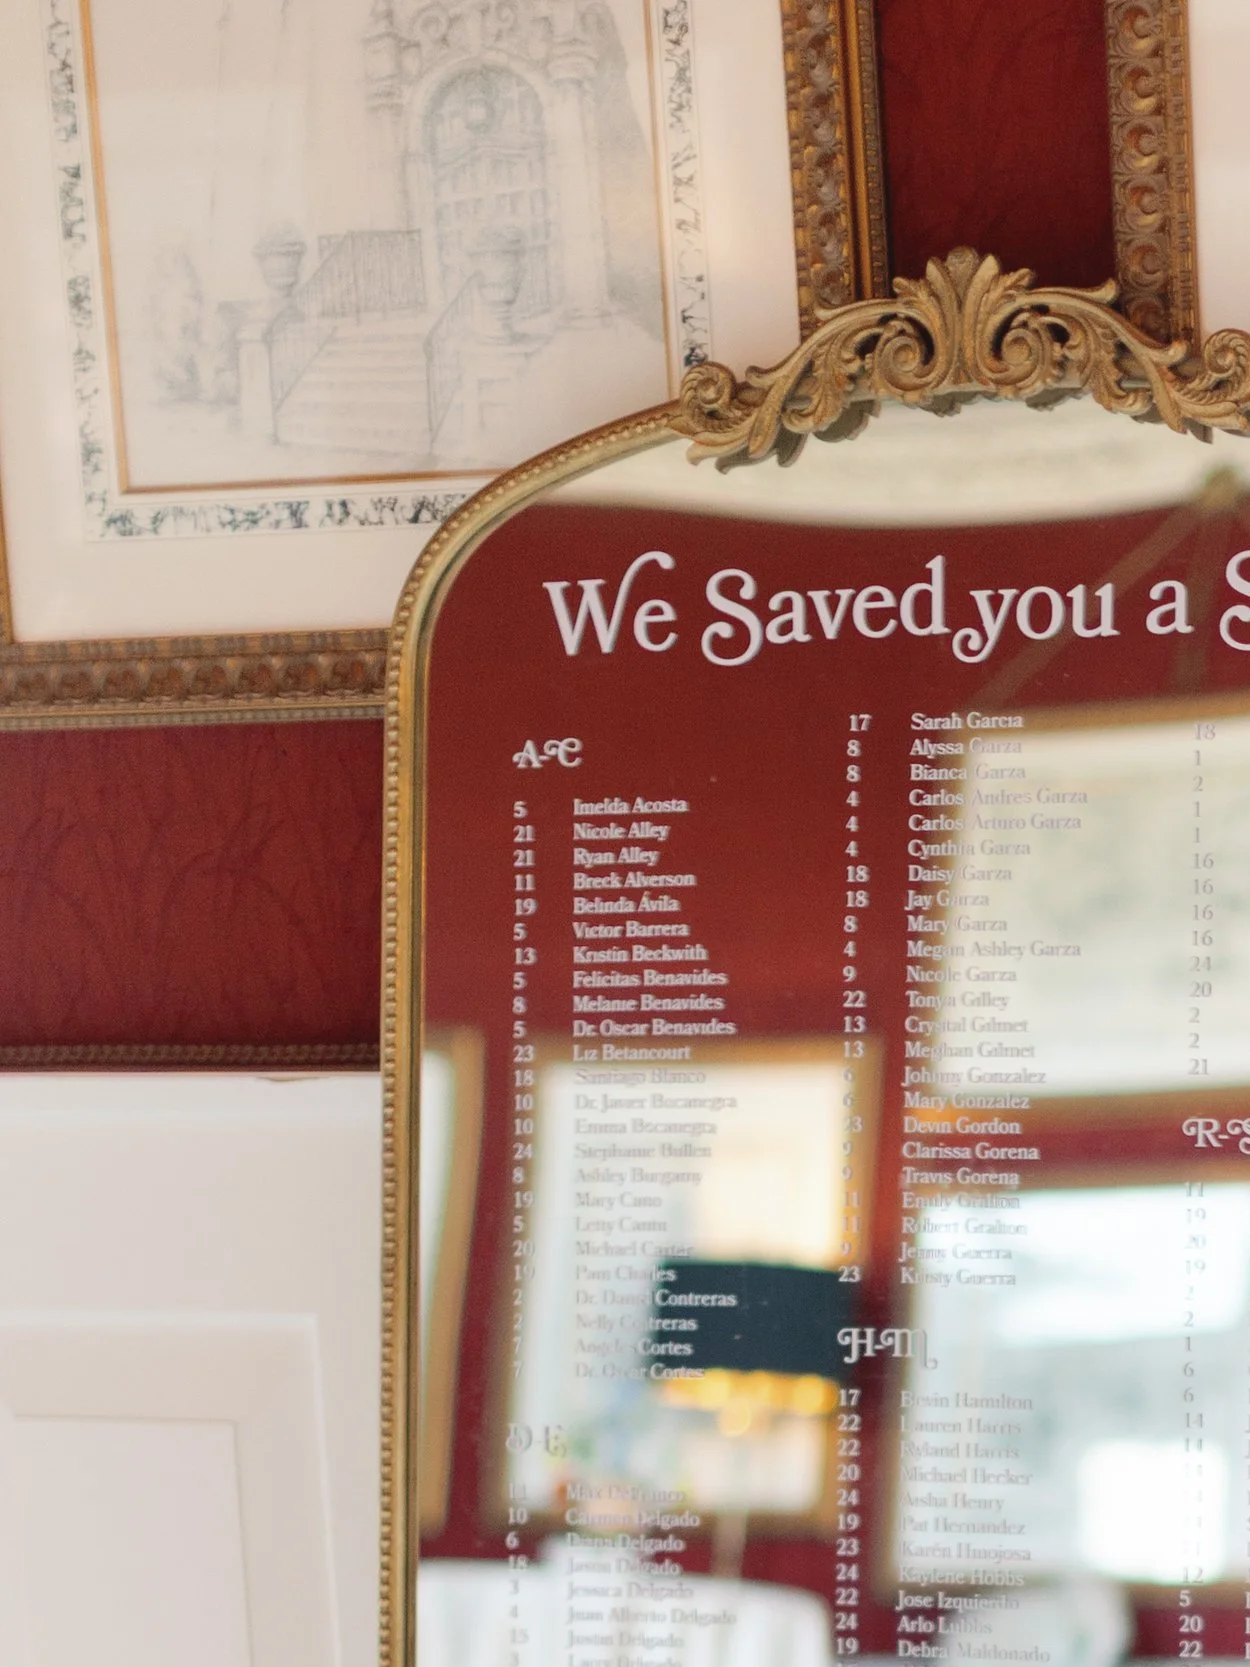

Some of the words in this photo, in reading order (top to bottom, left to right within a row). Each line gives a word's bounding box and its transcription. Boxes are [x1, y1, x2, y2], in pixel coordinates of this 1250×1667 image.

[542, 550, 678, 656] We
[701, 555, 951, 666] Saved
[952, 583, 1120, 664] you
[1146, 580, 1194, 635] a
[850, 714, 872, 731] 17
[911, 713, 963, 730] Sarah
[967, 712, 1023, 729] Garcia
[1195, 724, 1216, 740] 18
[847, 740, 861, 757] 8
[910, 739, 964, 759] Alyssa
[970, 738, 1022, 754] Garza
[846, 765, 861, 783] 8
[910, 764, 967, 781] Bianca
[976, 763, 1026, 779] Garza
[513, 801, 527, 818] 5
[573, 798, 629, 815] Imelda
[632, 797, 689, 813] Acosta
[513, 825, 535, 842] 21
[573, 823, 627, 840] Nicole
[628, 822, 671, 840] Alley
[846, 816, 859, 832] 4
[908, 814, 964, 831] Carlos
[972, 814, 1025, 830] Arturo
[1031, 814, 1081, 829] Garza
[1195, 828, 1200, 842] 1
[514, 898, 537, 915] 19
[573, 897, 635, 914] Belinda
[638, 891, 680, 912] Ávila
[1193, 905, 1213, 920] 16
[514, 947, 537, 965] 13
[632, 944, 708, 961] Beckwith
[513, 972, 526, 989] 5
[573, 971, 640, 988] Felicitas
[644, 969, 728, 986] Benavides
[513, 1021, 526, 1038] 5
[573, 1020, 597, 1037] Dr.
[600, 1019, 649, 1036] Oscar
[652, 1018, 737, 1035] Benavides
[1189, 1034, 1200, 1048] 2
[514, 1045, 534, 1062] 23
[573, 1044, 597, 1061] Liz
[602, 1043, 691, 1060] Betancourt
[1188, 1060, 1209, 1075] 21
[514, 1069, 533, 1086] 18
[904, 1116, 952, 1133] Devin
[956, 1118, 1022, 1134] Gordon
[902, 1142, 971, 1159] Clarissa
[975, 1143, 1039, 1160] Gorena
[902, 1168, 952, 1184] Travis
[957, 1168, 1020, 1185] Gorena
[836, 1589, 859, 1606] 22
[896, 1591, 932, 1611] Jose
[1180, 1591, 1191, 1608] 5
[1179, 1641, 1202, 1658] 22
